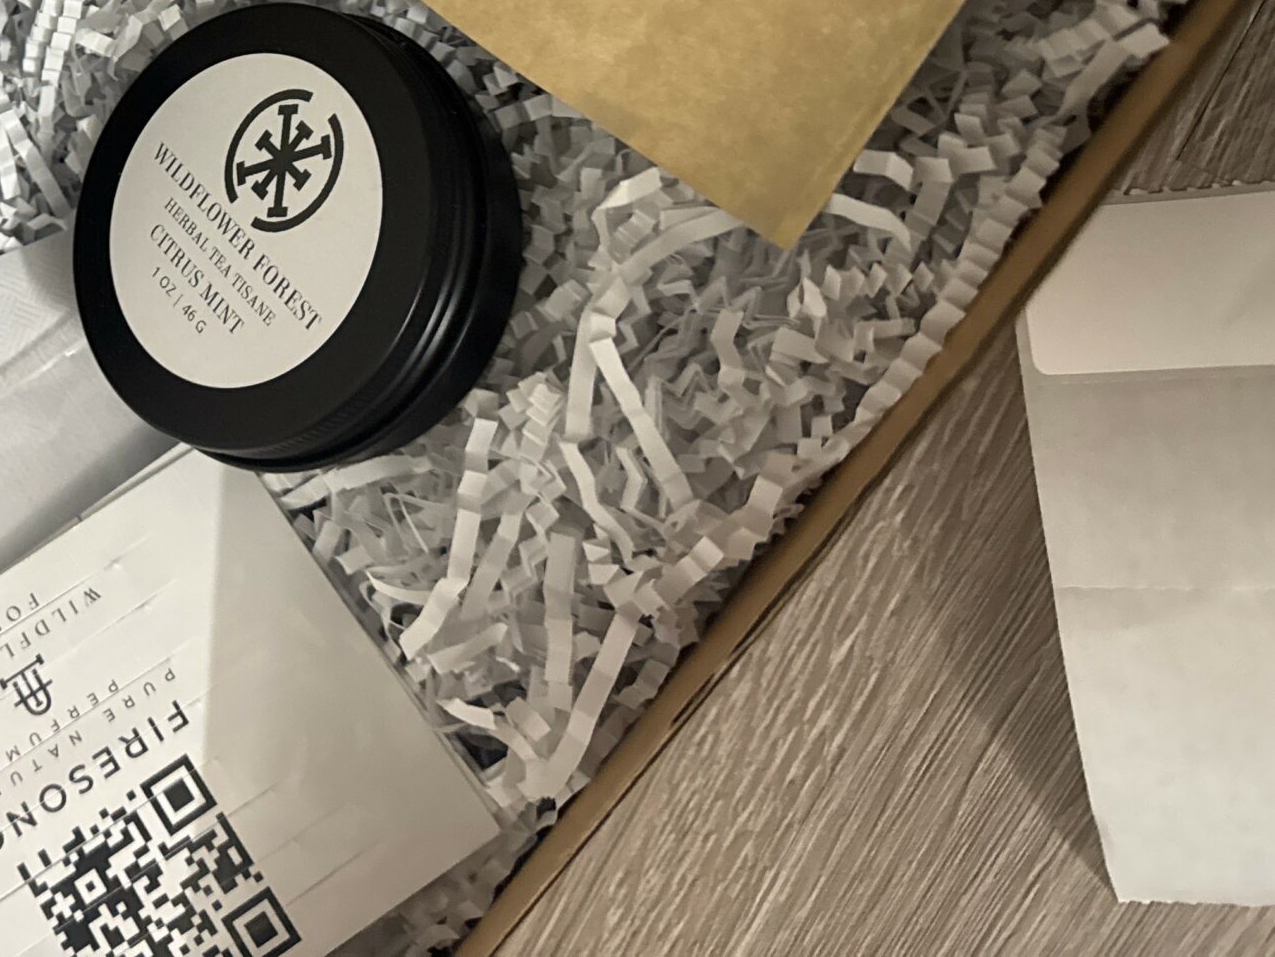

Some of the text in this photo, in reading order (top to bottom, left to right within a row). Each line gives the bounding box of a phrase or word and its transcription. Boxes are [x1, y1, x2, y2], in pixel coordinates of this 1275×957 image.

[150, 223, 245, 335] CITRUS MINT
[154, 141, 323, 331] WILDFLOWER FOREST
[164, 197, 277, 327] HERBAL TEA TISANE
[151, 266, 161, 278] 1
[159, 275, 177, 298] OZ
[181, 304, 197, 322] 46
[195, 320, 207, 334] G
[102, 667, 176, 723] PURE
